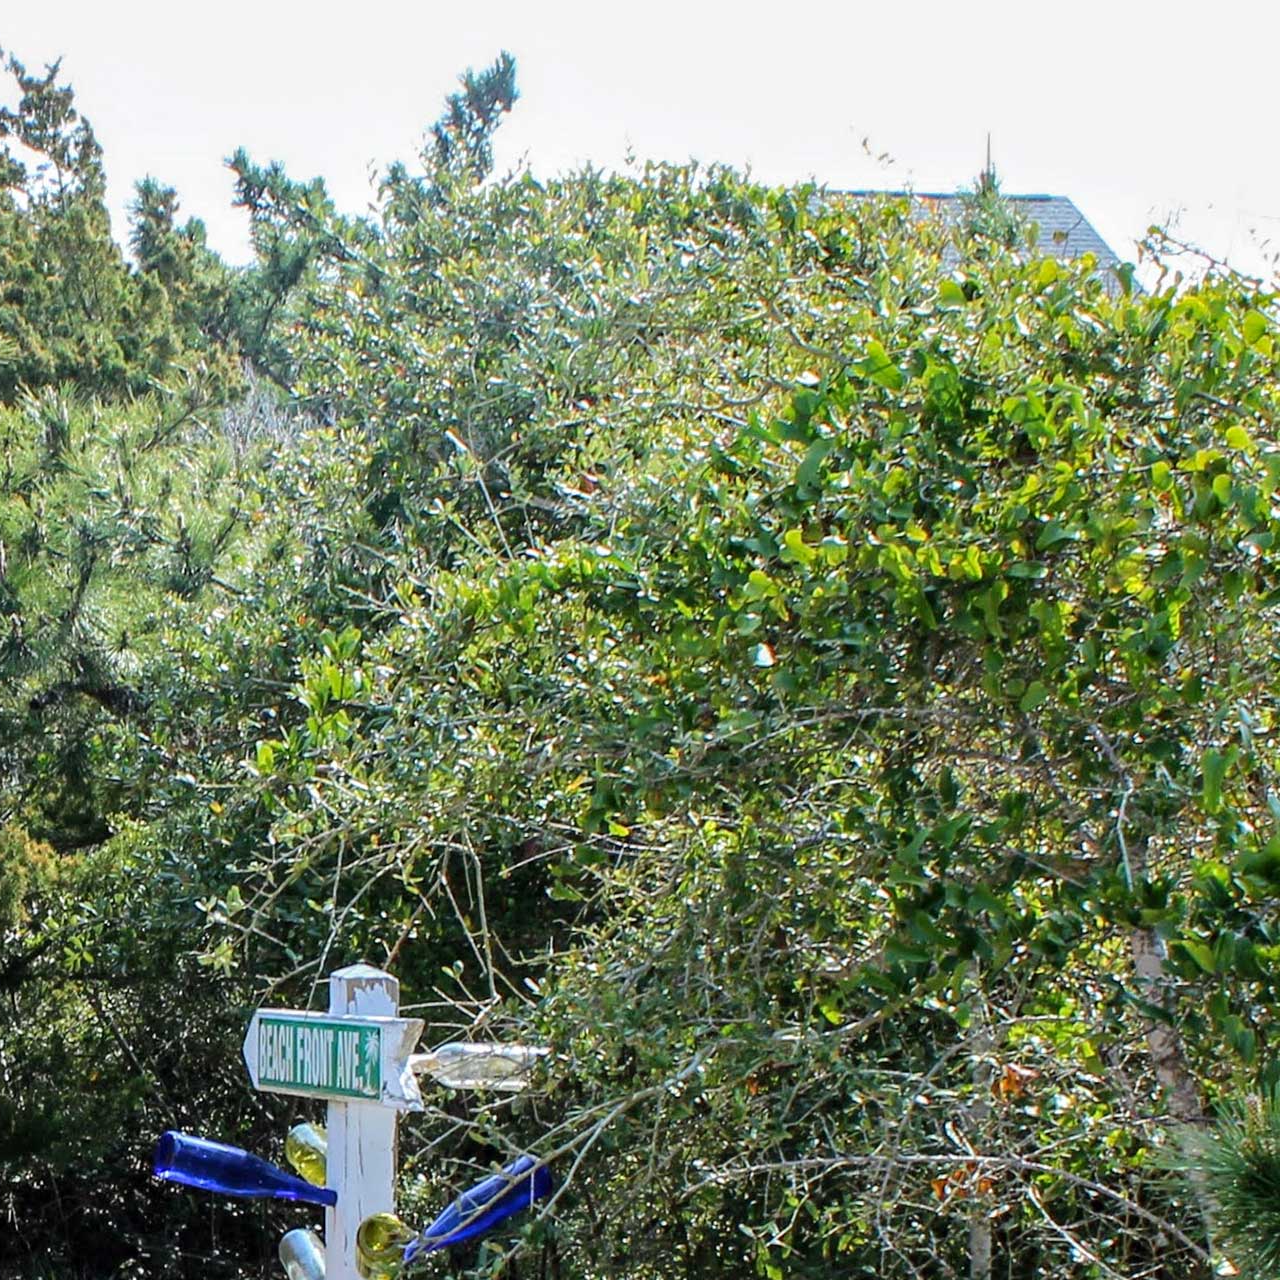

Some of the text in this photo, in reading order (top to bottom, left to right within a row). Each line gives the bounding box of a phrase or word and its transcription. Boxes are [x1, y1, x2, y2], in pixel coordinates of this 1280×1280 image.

[259, 1024, 363, 1090] BEACH FRONT AVE.
